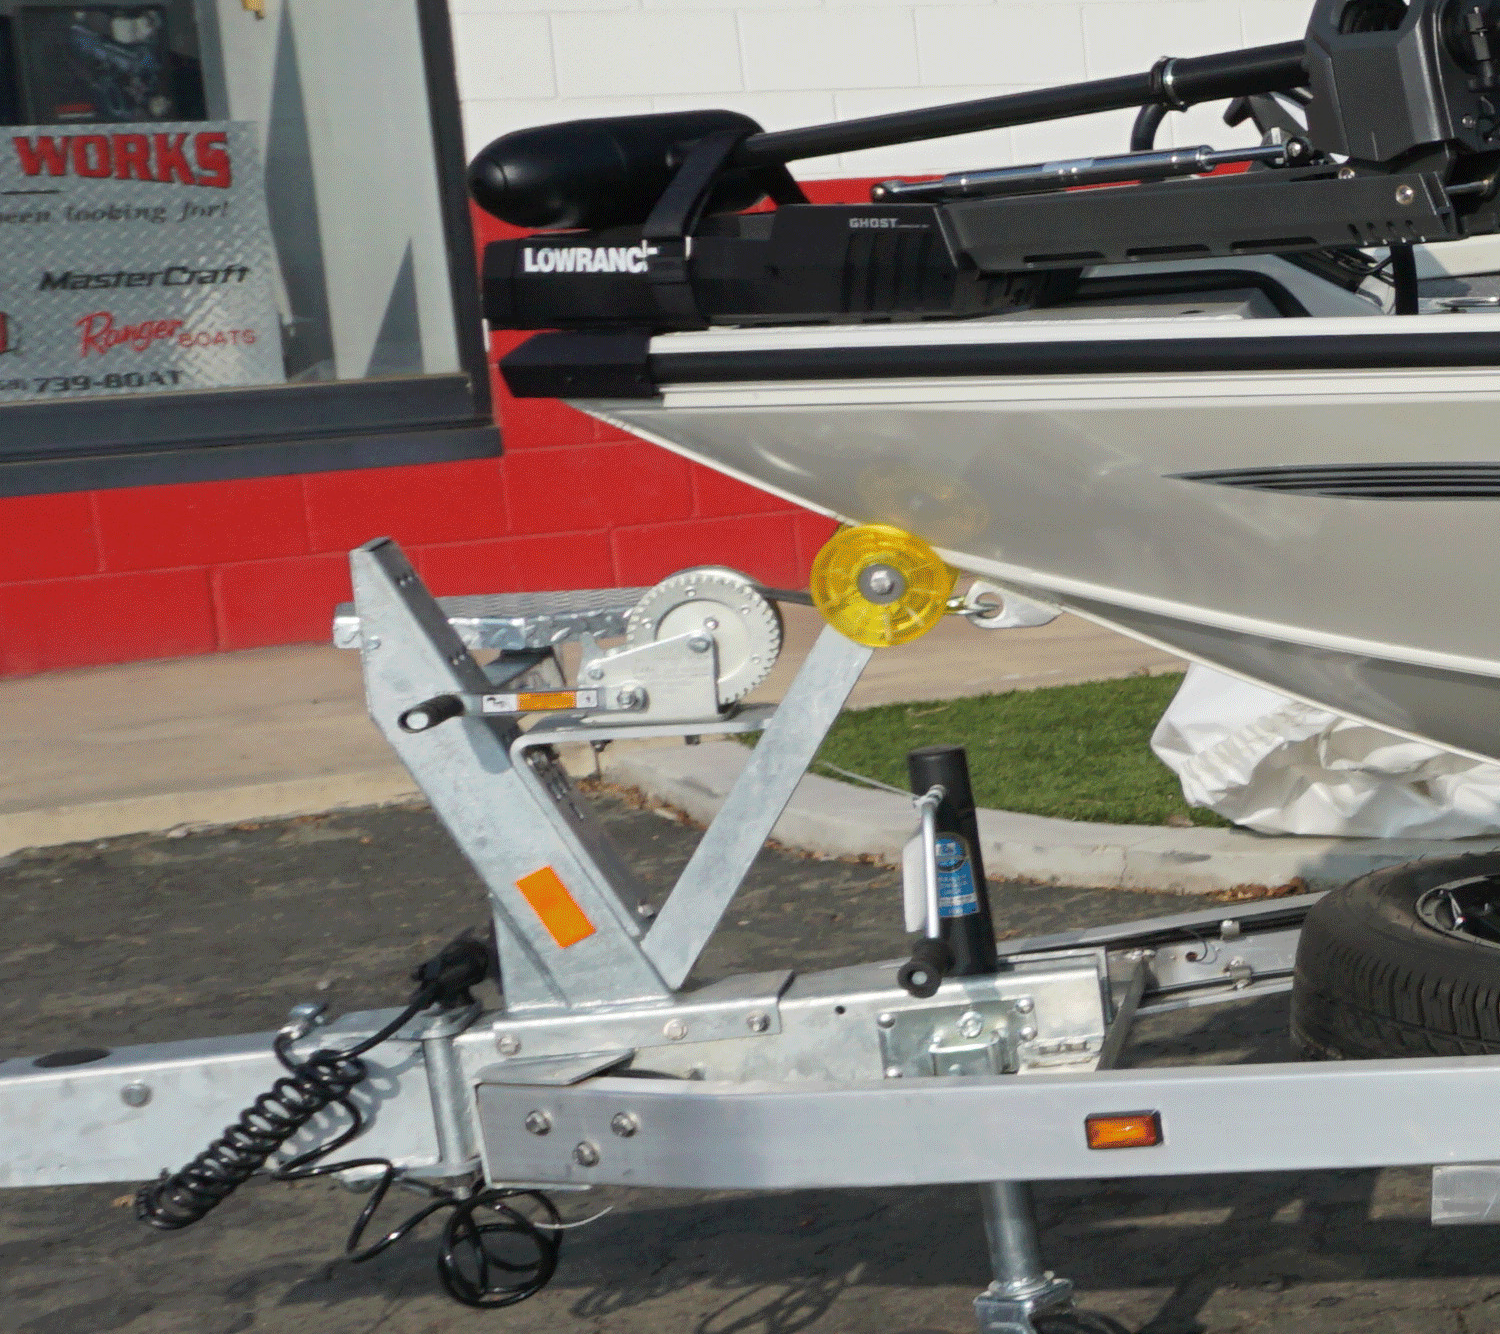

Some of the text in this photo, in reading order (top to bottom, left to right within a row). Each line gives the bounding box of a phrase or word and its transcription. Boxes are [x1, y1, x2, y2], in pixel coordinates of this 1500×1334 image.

[12, 131, 234, 190] WORKS
[848, 217, 899, 229] GHOST
[38, 264, 251, 292] MasterCraft
[75, 310, 258, 358] Ranger BOATS
[32, 369, 184, 394] 739-BOAT
